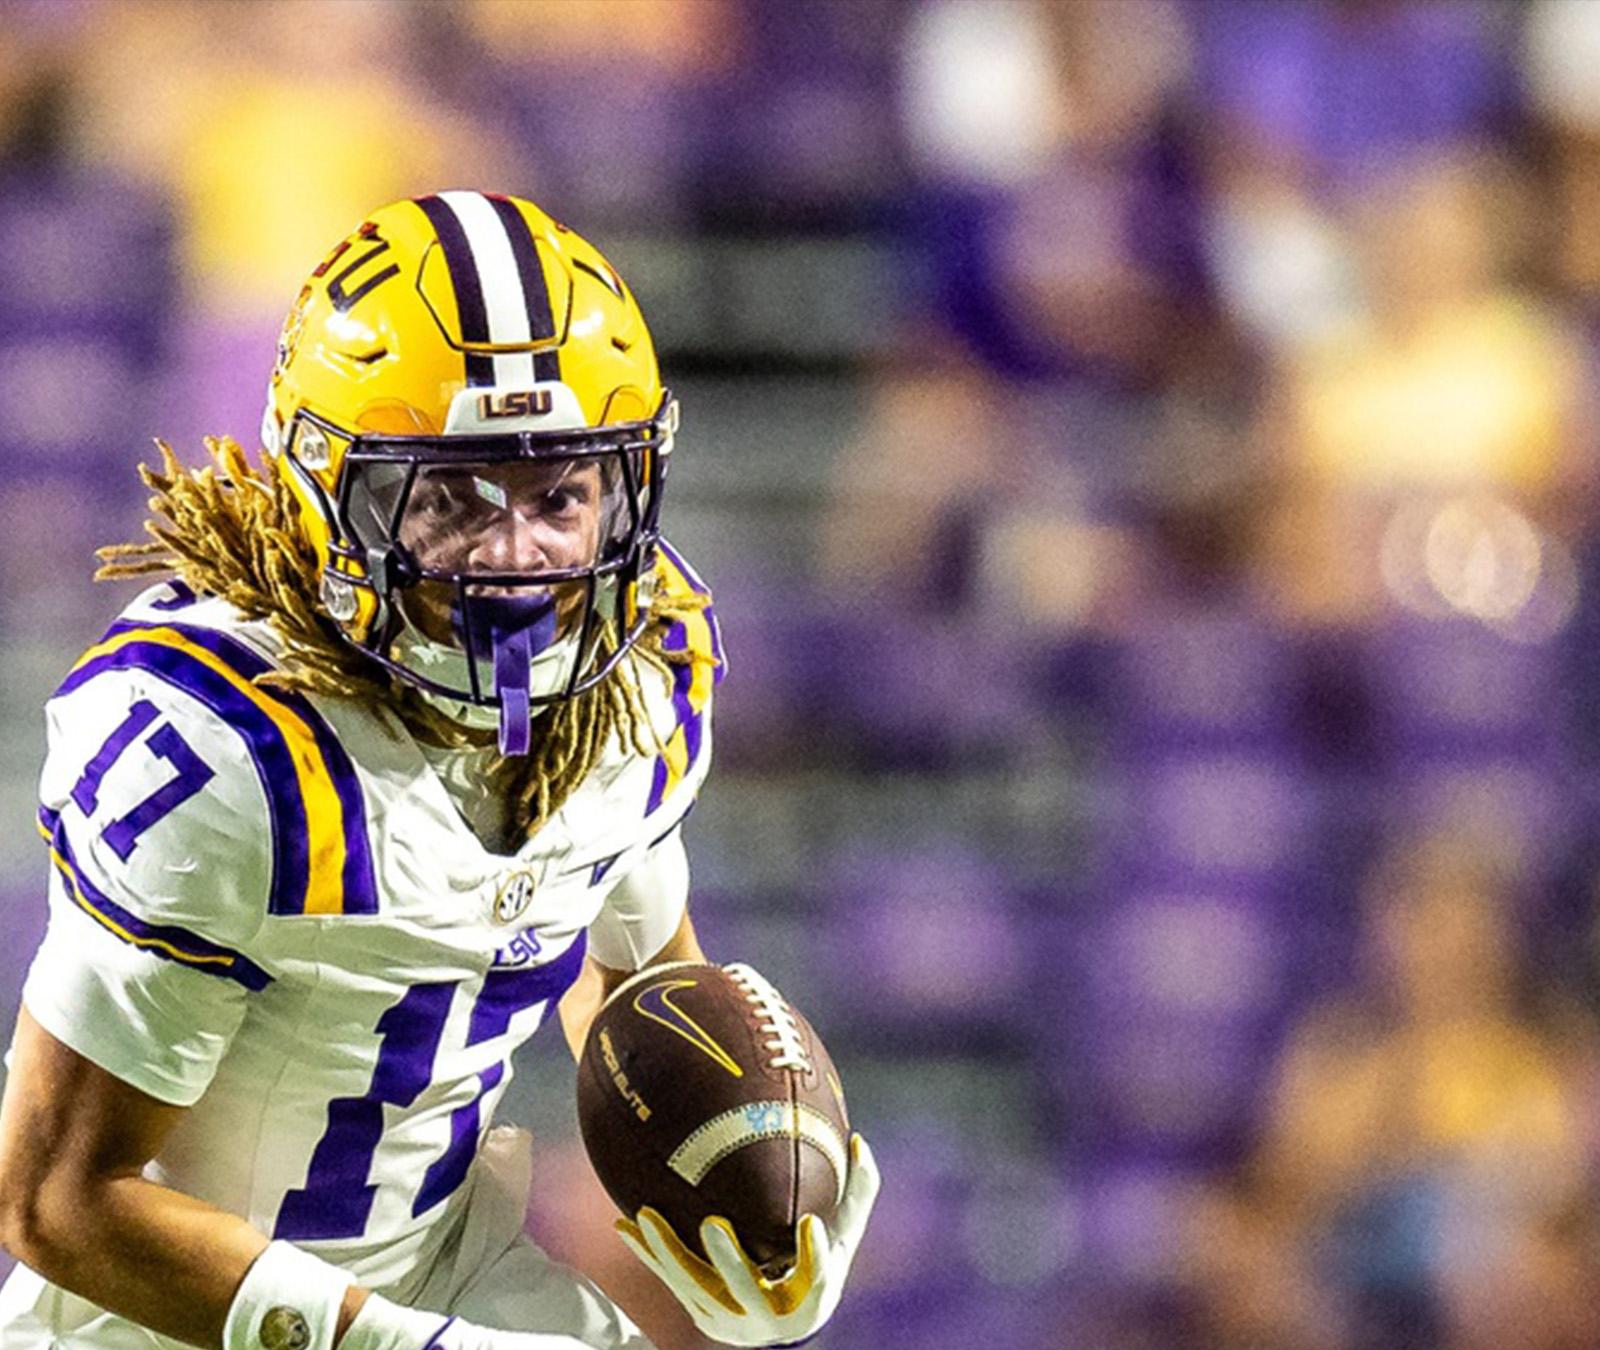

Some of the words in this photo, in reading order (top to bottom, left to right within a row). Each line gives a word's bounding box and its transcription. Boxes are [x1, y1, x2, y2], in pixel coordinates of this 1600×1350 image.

[477, 390, 553, 420] LSU
[70, 699, 215, 863] 17
[272, 926, 589, 1242] 17
